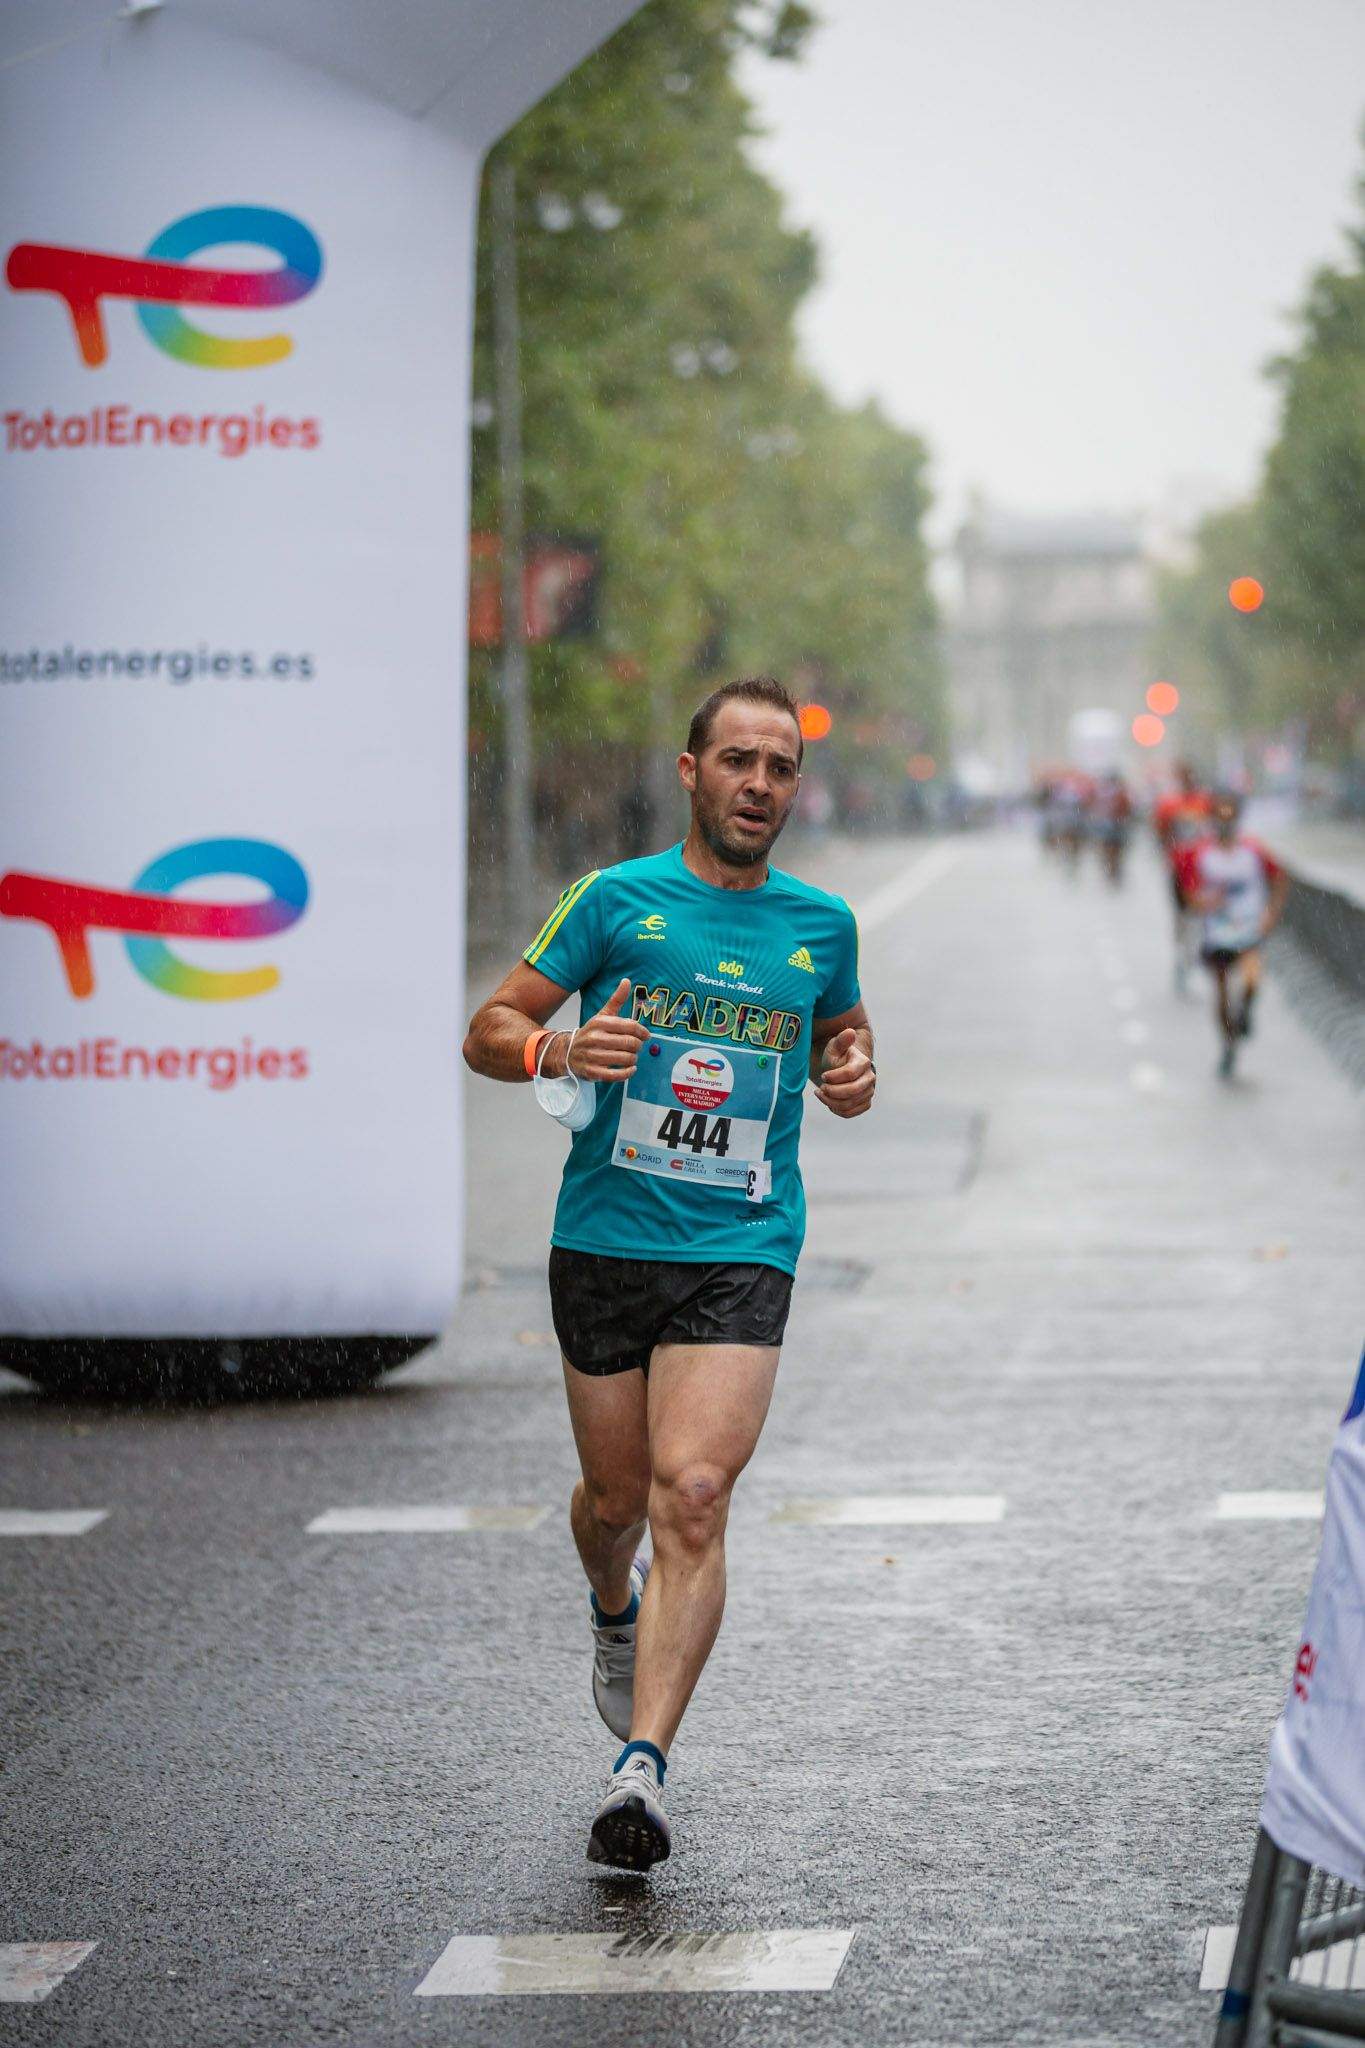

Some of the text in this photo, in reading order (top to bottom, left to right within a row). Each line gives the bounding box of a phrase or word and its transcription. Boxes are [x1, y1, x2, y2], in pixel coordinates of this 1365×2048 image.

[4, 405, 321, 458] TotalEnergies
[694, 972, 727, 988] Rock
[735, 981, 764, 995] Roll
[717, 960, 744, 979] edp
[787, 957, 815, 974] adidas
[631, 984, 803, 1051] MADRID
[0, 1035, 308, 1090] TotalEnergies
[685, 1075, 723, 1087] TotalEnergies
[656, 1108, 732, 1157] 444
